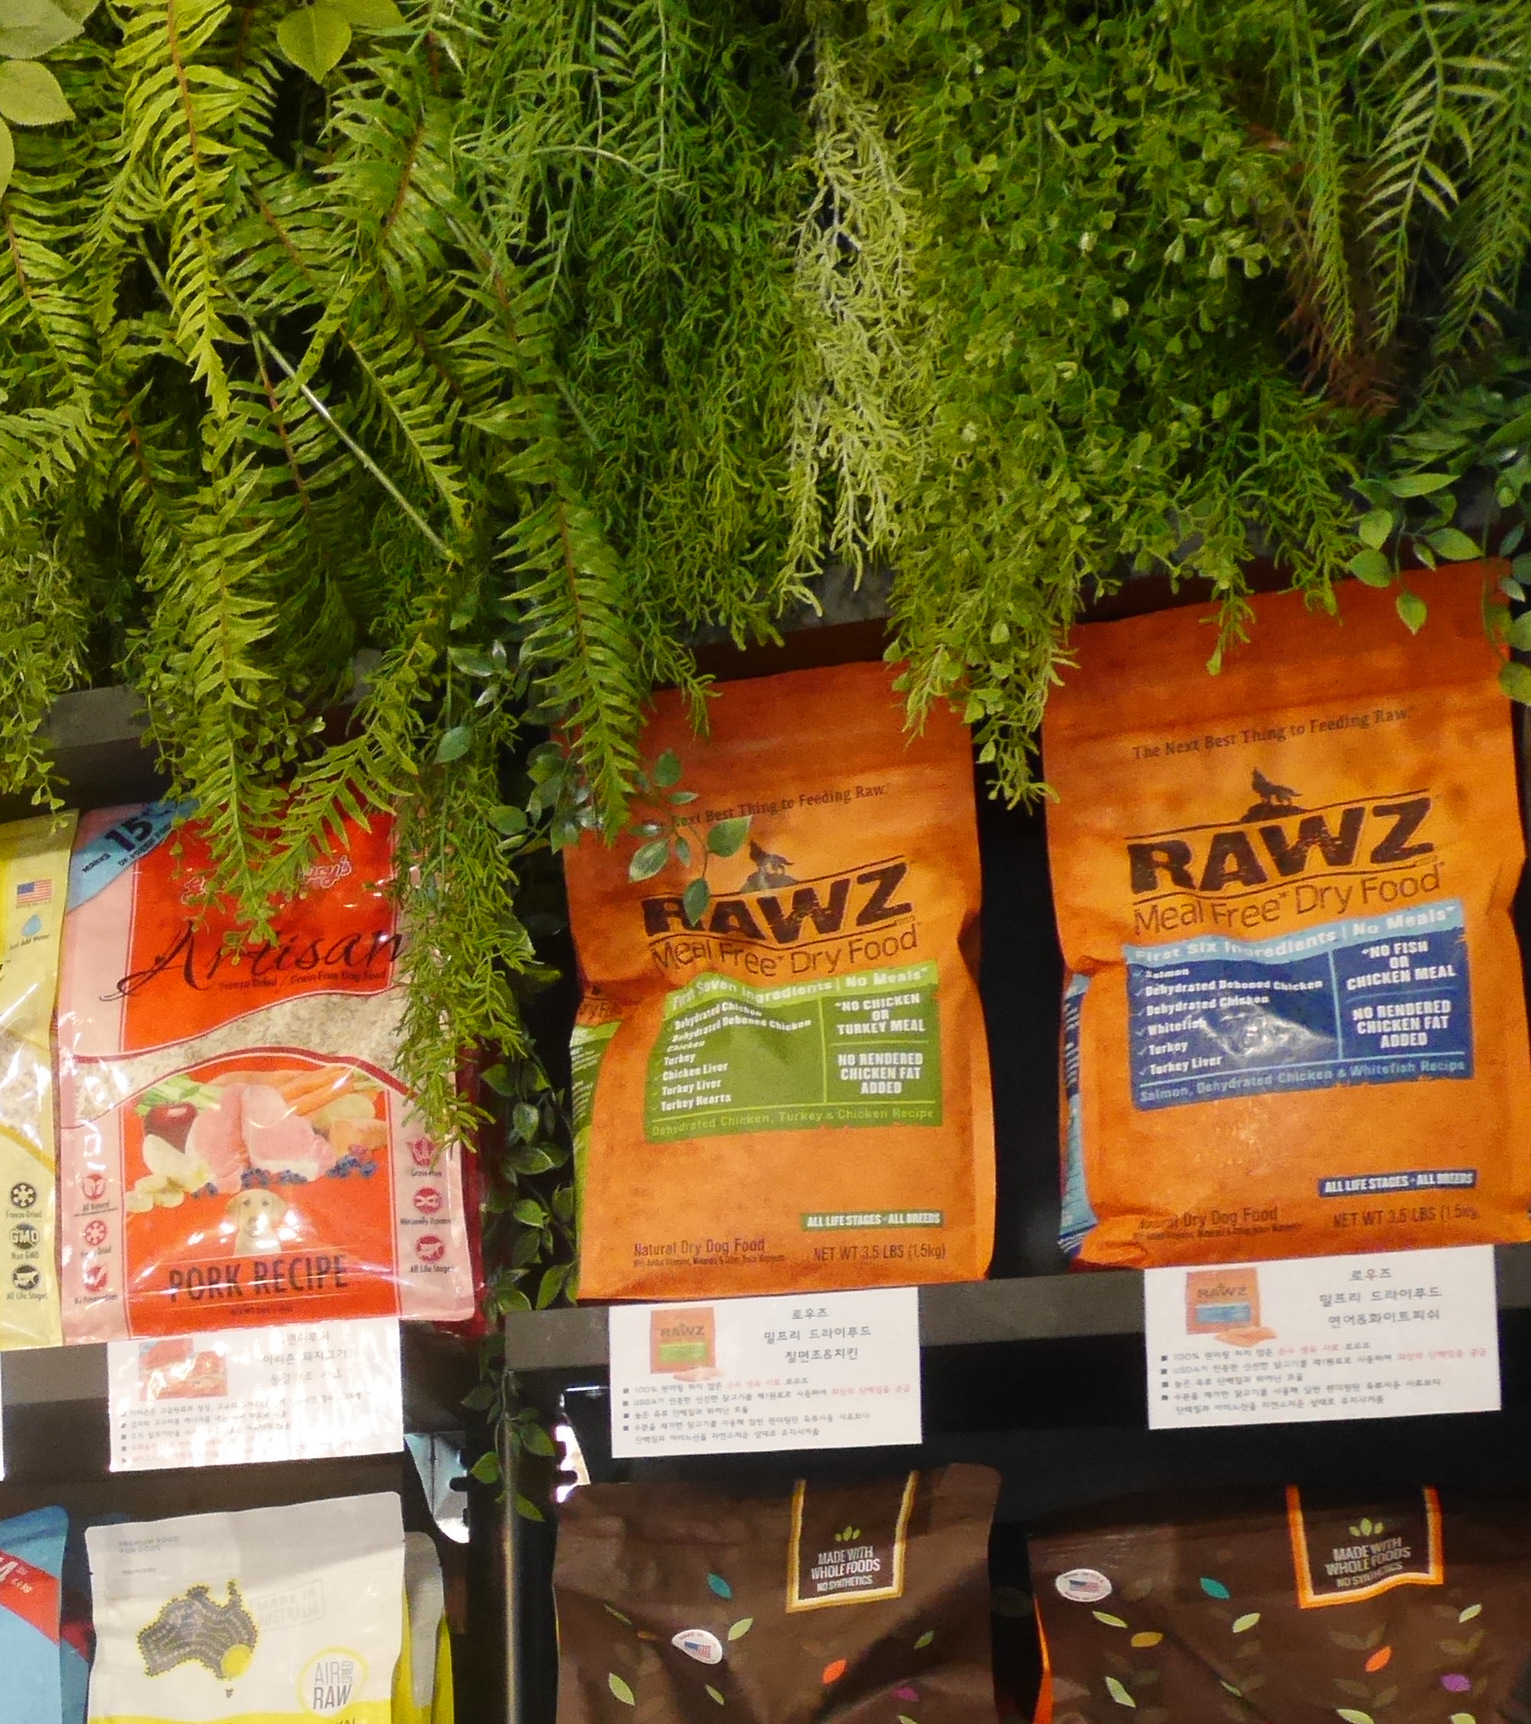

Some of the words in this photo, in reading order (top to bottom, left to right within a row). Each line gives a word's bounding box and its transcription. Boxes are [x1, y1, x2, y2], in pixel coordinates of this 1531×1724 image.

[1133, 744, 1161, 760] The
[1165, 739, 1200, 756] Next
[1205, 734, 1237, 751] Best
[1240, 726, 1286, 745] Thing
[1291, 723, 1305, 736] to
[1310, 712, 1370, 735] Feeding
[1127, 796, 1434, 895] RAWZ
[641, 862, 912, 944] RAWZ
[1134, 901, 1203, 936] Meal
[1296, 884, 1353, 916] Dry
[1361, 870, 1441, 904] Food
[1347, 970, 1411, 990] CHICKEN
[1415, 965, 1456, 980] MEAL
[1352, 1007, 1373, 1021] NO
[1377, 1000, 1451, 1018] RENDERED
[837, 1022, 886, 1034] TURKEY
[890, 1020, 925, 1032] MEAL
[1357, 1018, 1420, 1033] CHICKEN
[1423, 1016, 1448, 1030] FAT
[1380, 1032, 1427, 1049] ADDED
[169, 1266, 243, 1303] PORK
[254, 1254, 348, 1295] RECIPE
[811, 1564, 845, 1580] WHOLE
[846, 1558, 880, 1574] FOODS
[313, 1684, 352, 1710] RAW
